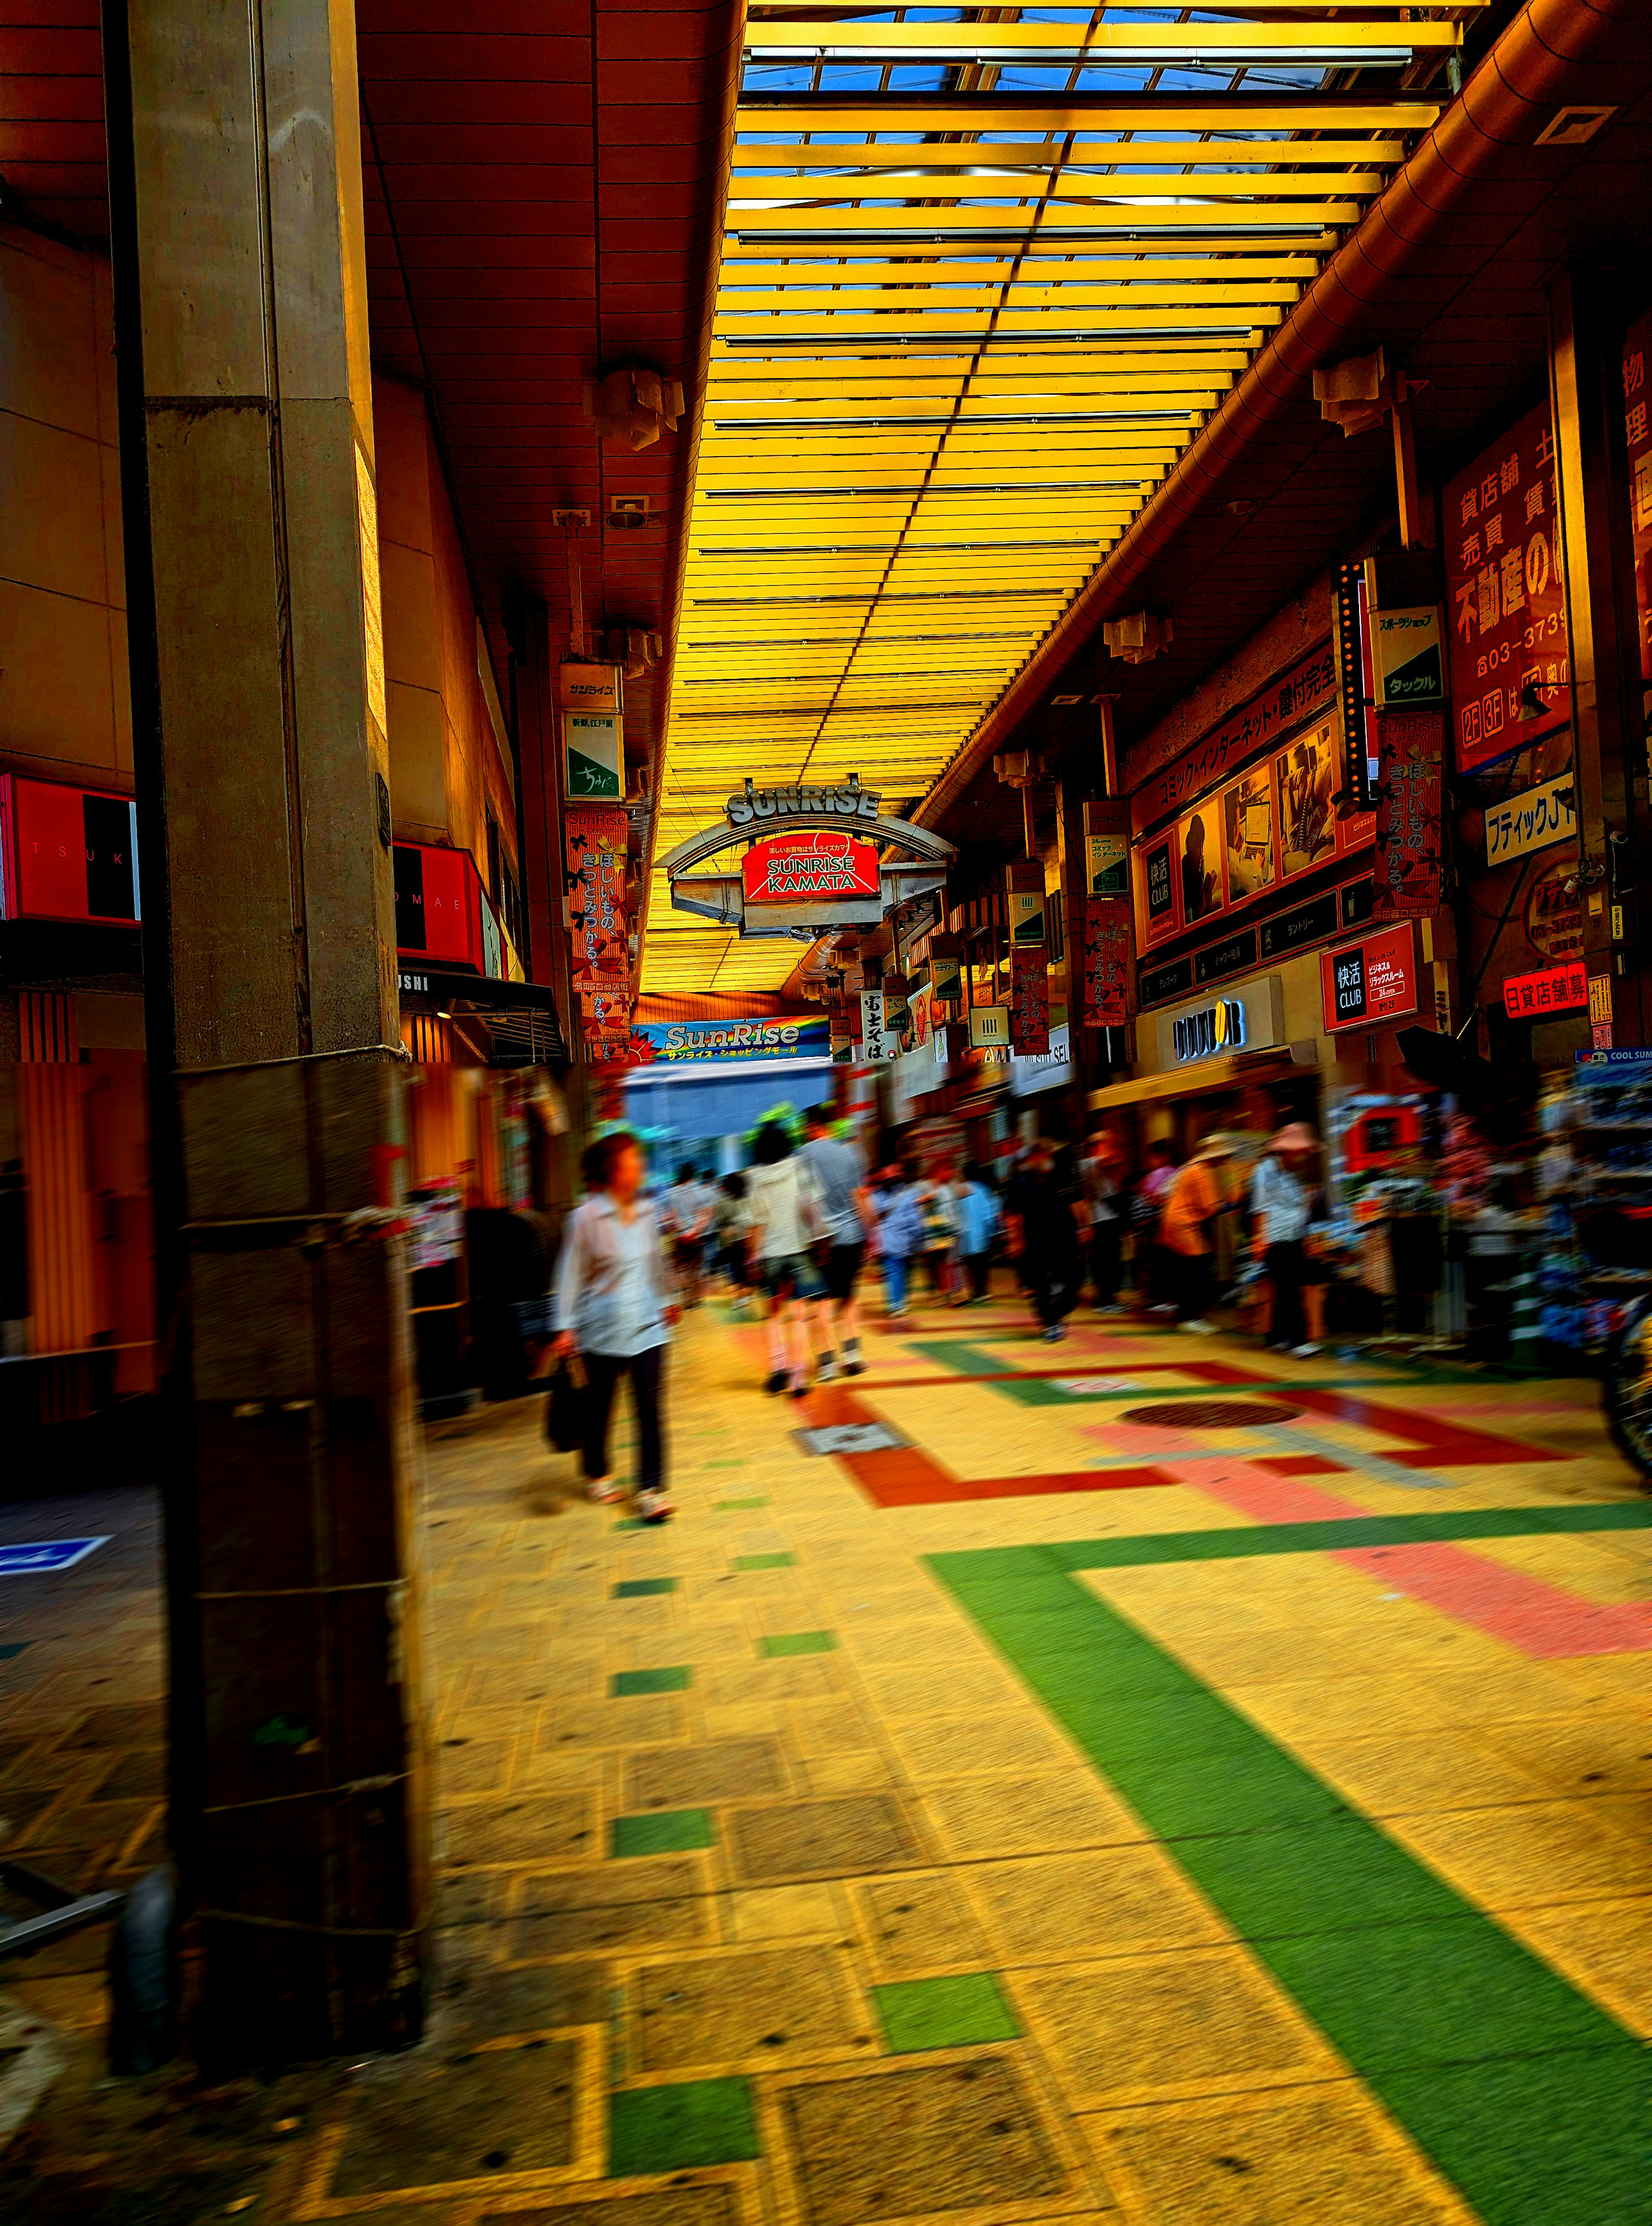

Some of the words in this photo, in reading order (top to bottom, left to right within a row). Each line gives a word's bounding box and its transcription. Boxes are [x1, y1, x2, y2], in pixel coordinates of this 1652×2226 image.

[1622, 350, 1644, 397] 物
[1625, 401, 1649, 447] 理
[1460, 452, 1519, 528] 貸店舗
[1461, 513, 1504, 571] 売買
[1380, 614, 1432, 631] スポーツショップ
[570, 684, 615, 695] サンライズ
[1389, 675, 1436, 694] タックル
[1380, 719, 1441, 733] SunRise
[727, 784, 882, 824] SUNRISE
[569, 814, 626, 826] SunRise
[767, 855, 855, 877] SUNRISE
[1150, 856, 1167, 886] 快活
[767, 873, 857, 894] KAMATA
[1152, 884, 1168, 905] CLUB
[1338, 960, 1360, 989] 快活
[1368, 961, 1391, 975] ビジネス&
[1369, 968, 1404, 988] リラックスルーム
[1340, 988, 1362, 1009] CLUB
[664, 1023, 801, 1050] SunRise
[667, 1046, 798, 1062] サンライズ・ショッピングモール
[1611, 1051, 1634, 1060] COOL
